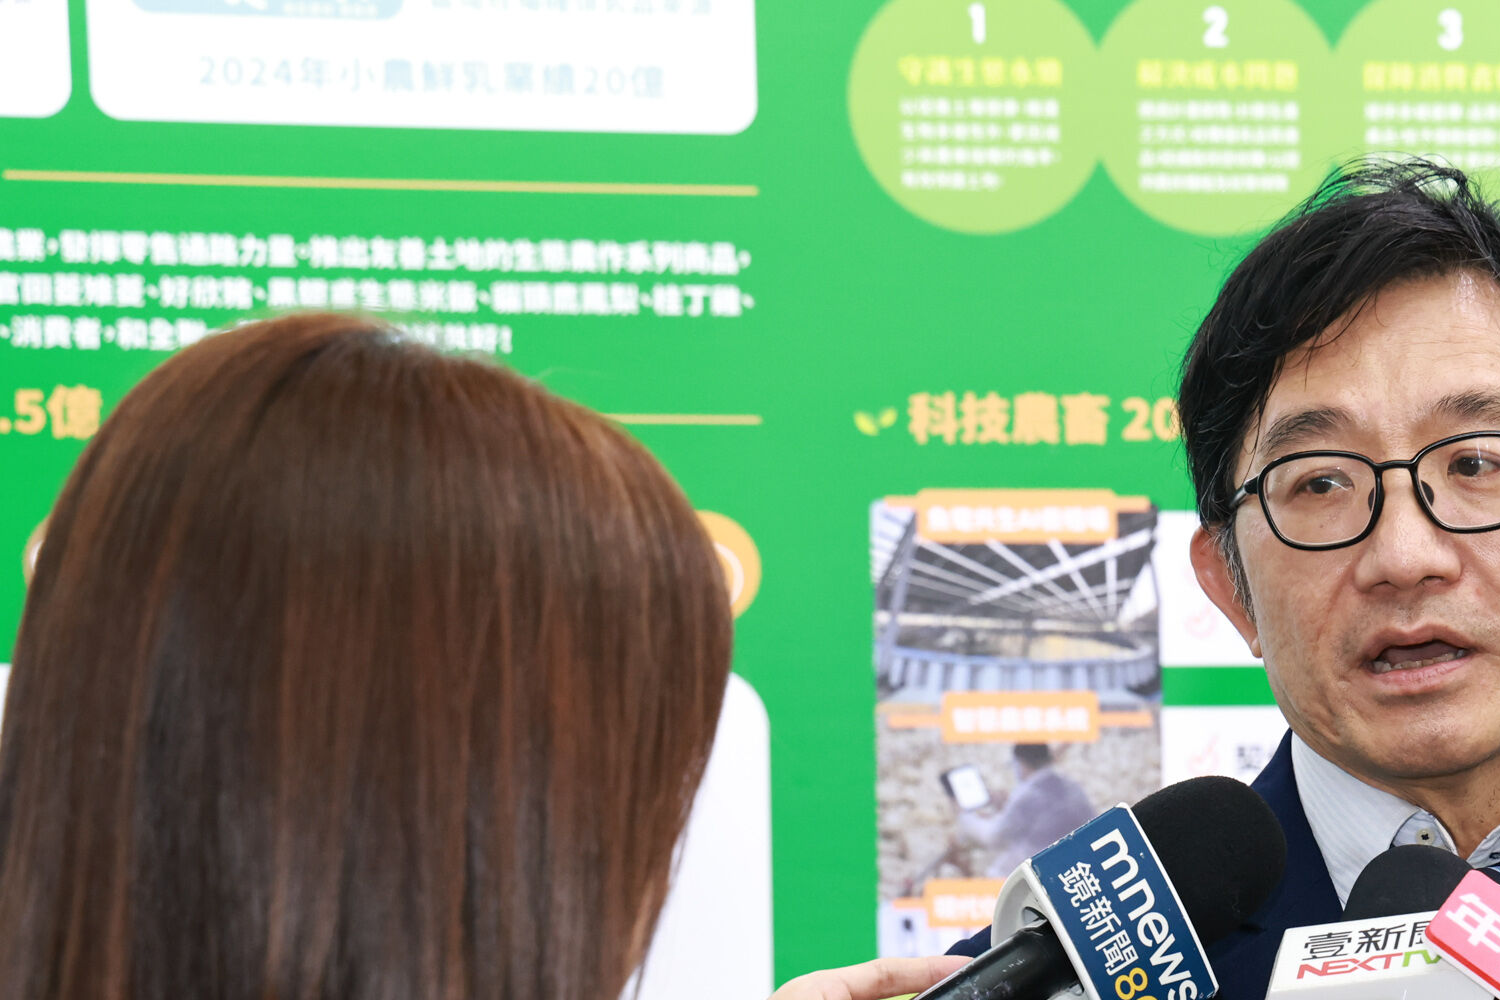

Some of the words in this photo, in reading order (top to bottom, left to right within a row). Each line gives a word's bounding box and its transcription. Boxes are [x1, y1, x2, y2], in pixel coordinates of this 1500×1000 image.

[968, 2, 987, 44] 1
[1202, 6, 1229, 48] 2
[1437, 8, 1464, 50] 3
[199, 55, 664, 99] 2024年小農鮮乳業績20億
[908, 391, 1111, 445] 科技農畜
